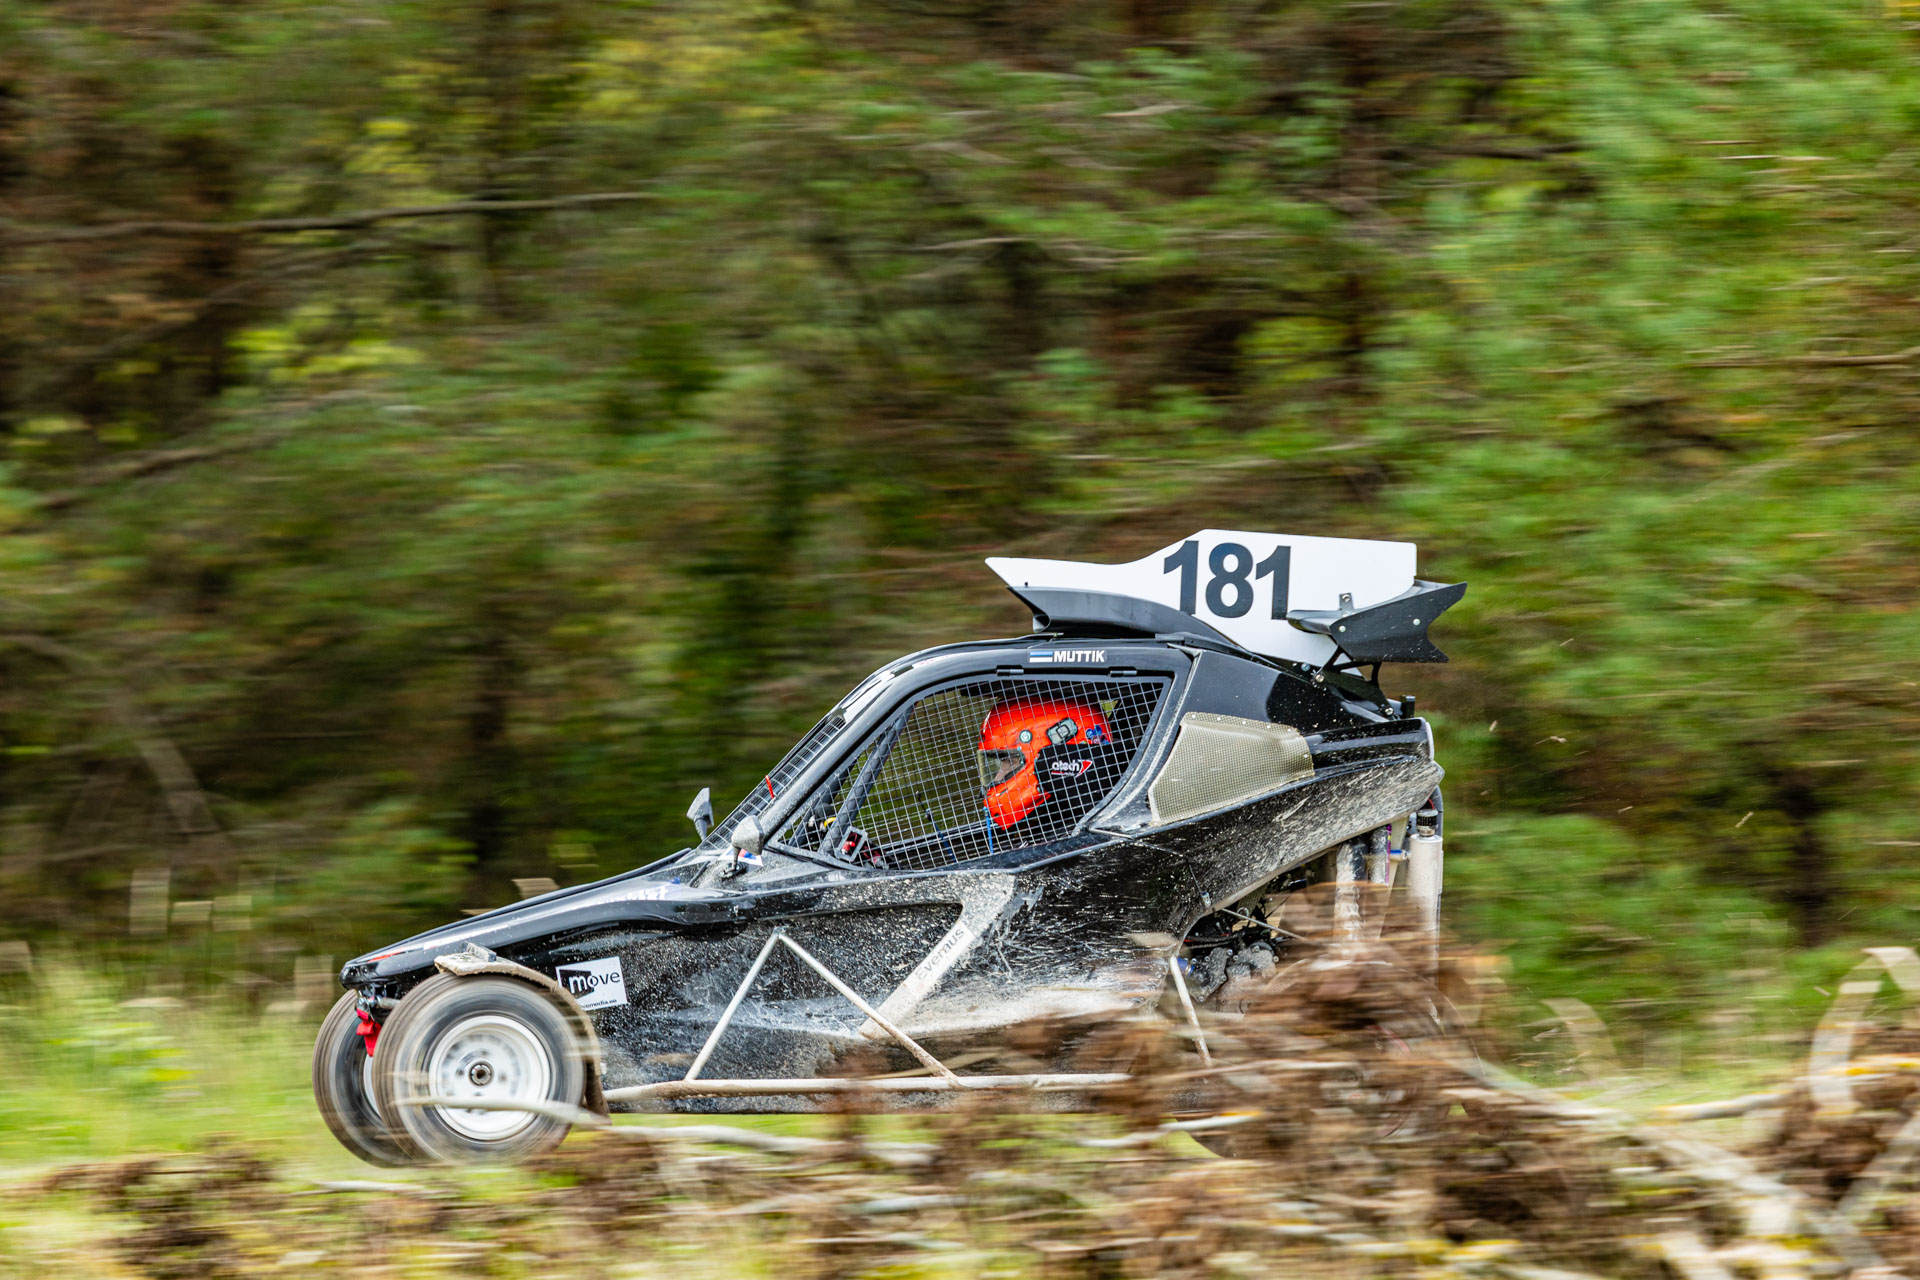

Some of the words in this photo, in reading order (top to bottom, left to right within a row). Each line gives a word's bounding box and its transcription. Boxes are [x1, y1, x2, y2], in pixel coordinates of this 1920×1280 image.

[1163, 540, 1291, 620] 181
[1053, 650, 1105, 662] MUTTIK
[915, 928, 965, 981] Everaus
[568, 971, 621, 994] move
